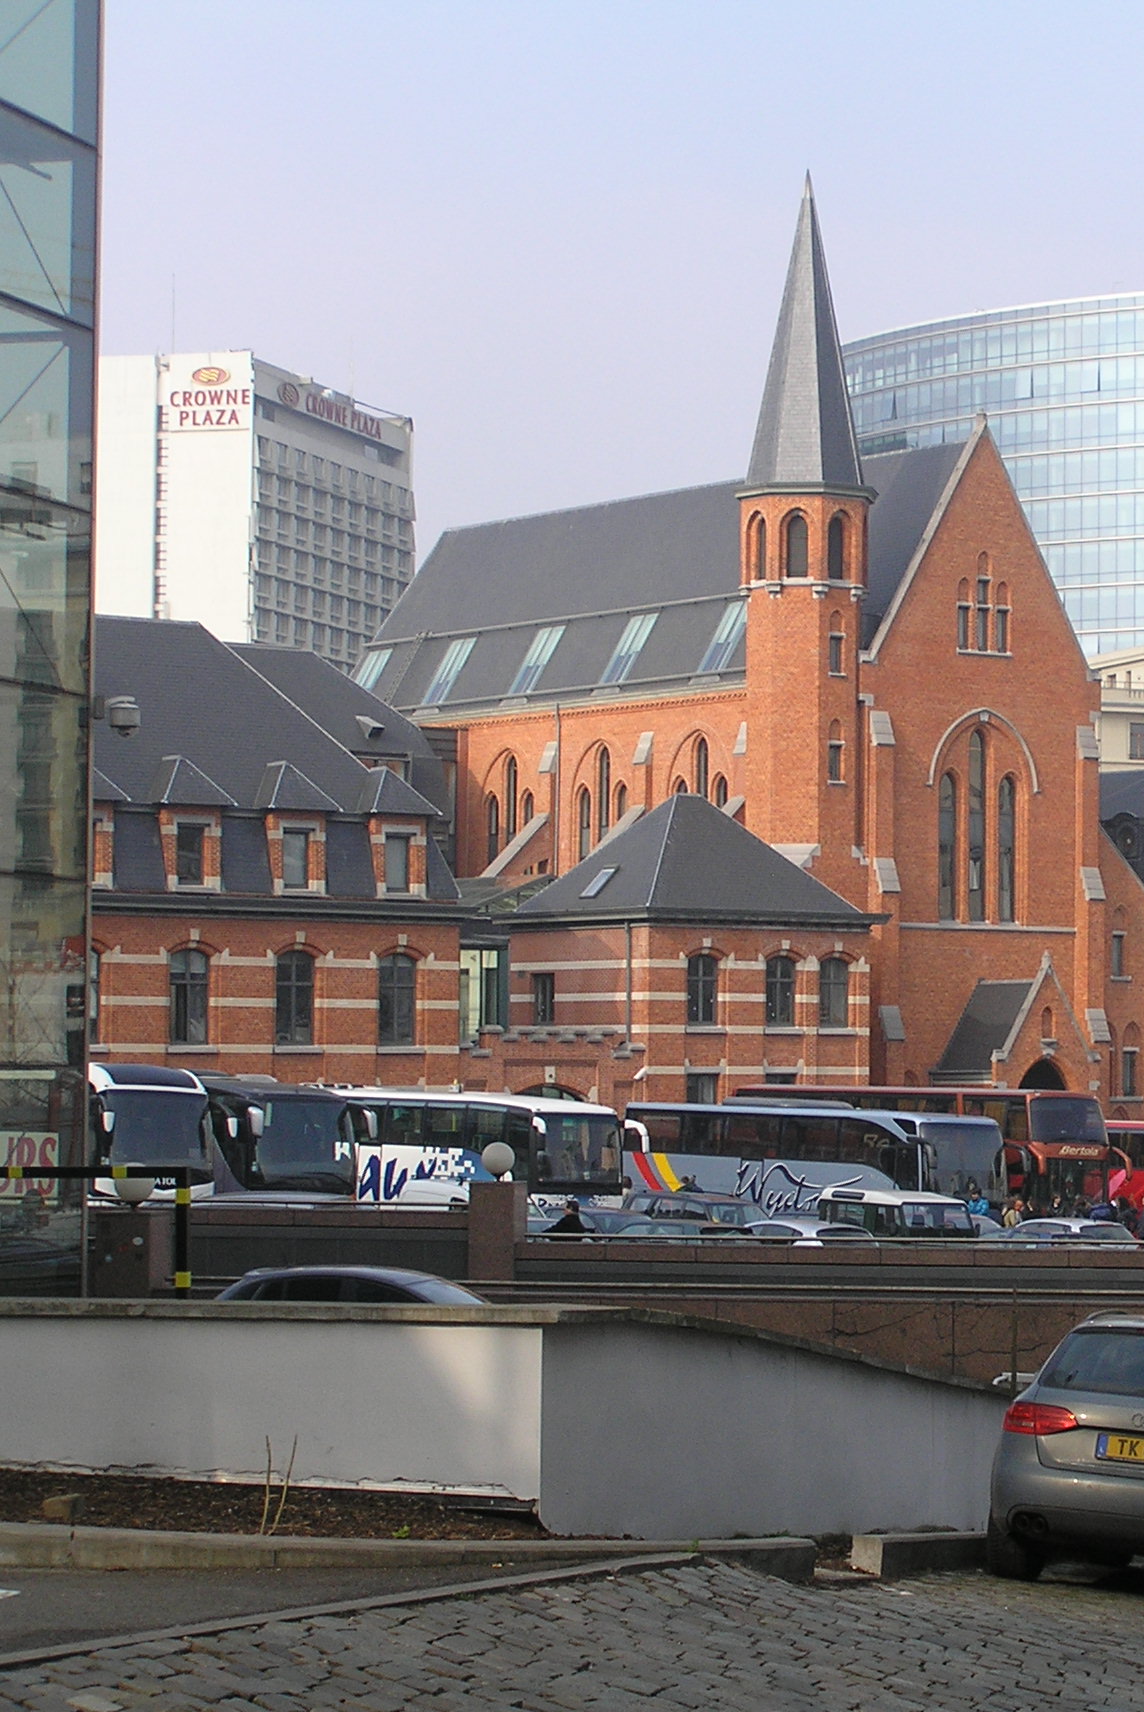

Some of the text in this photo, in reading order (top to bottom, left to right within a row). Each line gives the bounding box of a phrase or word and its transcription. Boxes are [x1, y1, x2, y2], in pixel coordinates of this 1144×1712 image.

[170, 389, 250, 407] CROWNE
[180, 409, 239, 426] PLAZA
[306, 393, 382, 441] CROWNE PLAZA
[1058, 1145, 1099, 1156] Bertola
[1118, 1439, 1140, 1458] TK
